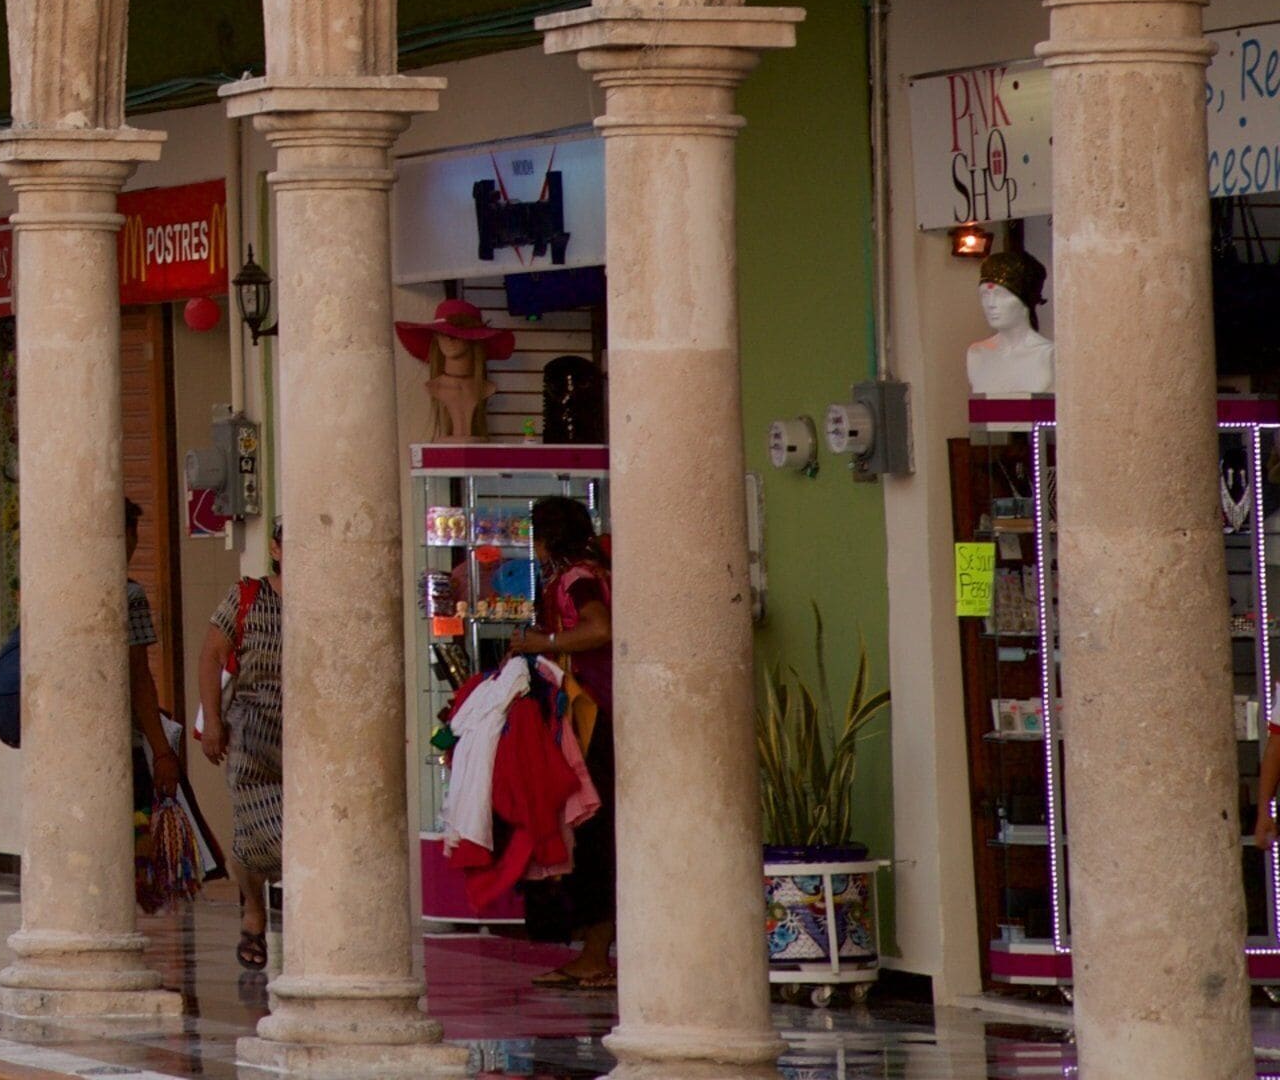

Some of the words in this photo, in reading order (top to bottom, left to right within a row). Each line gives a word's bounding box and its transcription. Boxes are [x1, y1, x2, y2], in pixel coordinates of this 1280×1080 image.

[947, 67, 1012, 167] PINK
[952, 128, 1017, 223] SHOP
[146, 219, 209, 266] POSTRES
